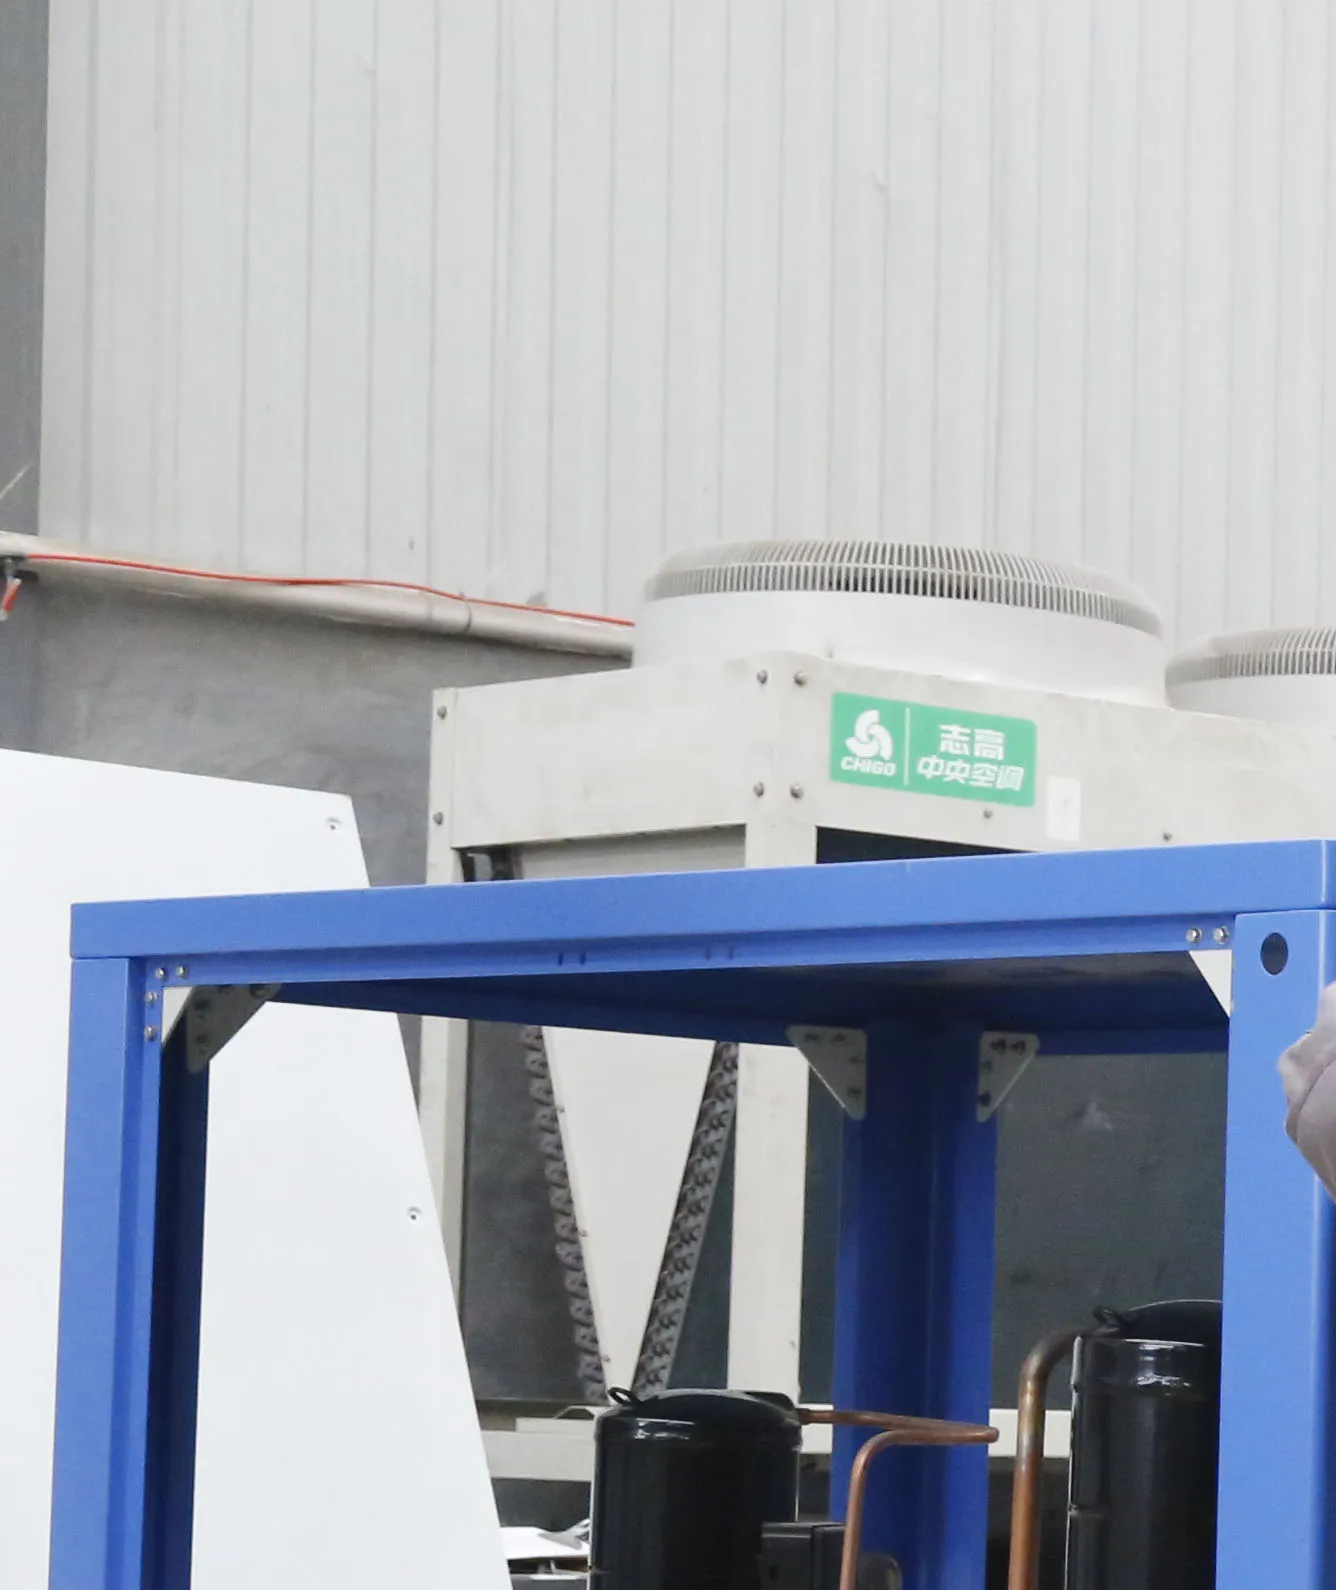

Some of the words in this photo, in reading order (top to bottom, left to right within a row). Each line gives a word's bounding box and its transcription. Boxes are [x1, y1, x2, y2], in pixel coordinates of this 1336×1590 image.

[939, 723, 1005, 761] 志高
[841, 756, 896, 777] CHIGO
[917, 754, 1025, 792] 中央空调
